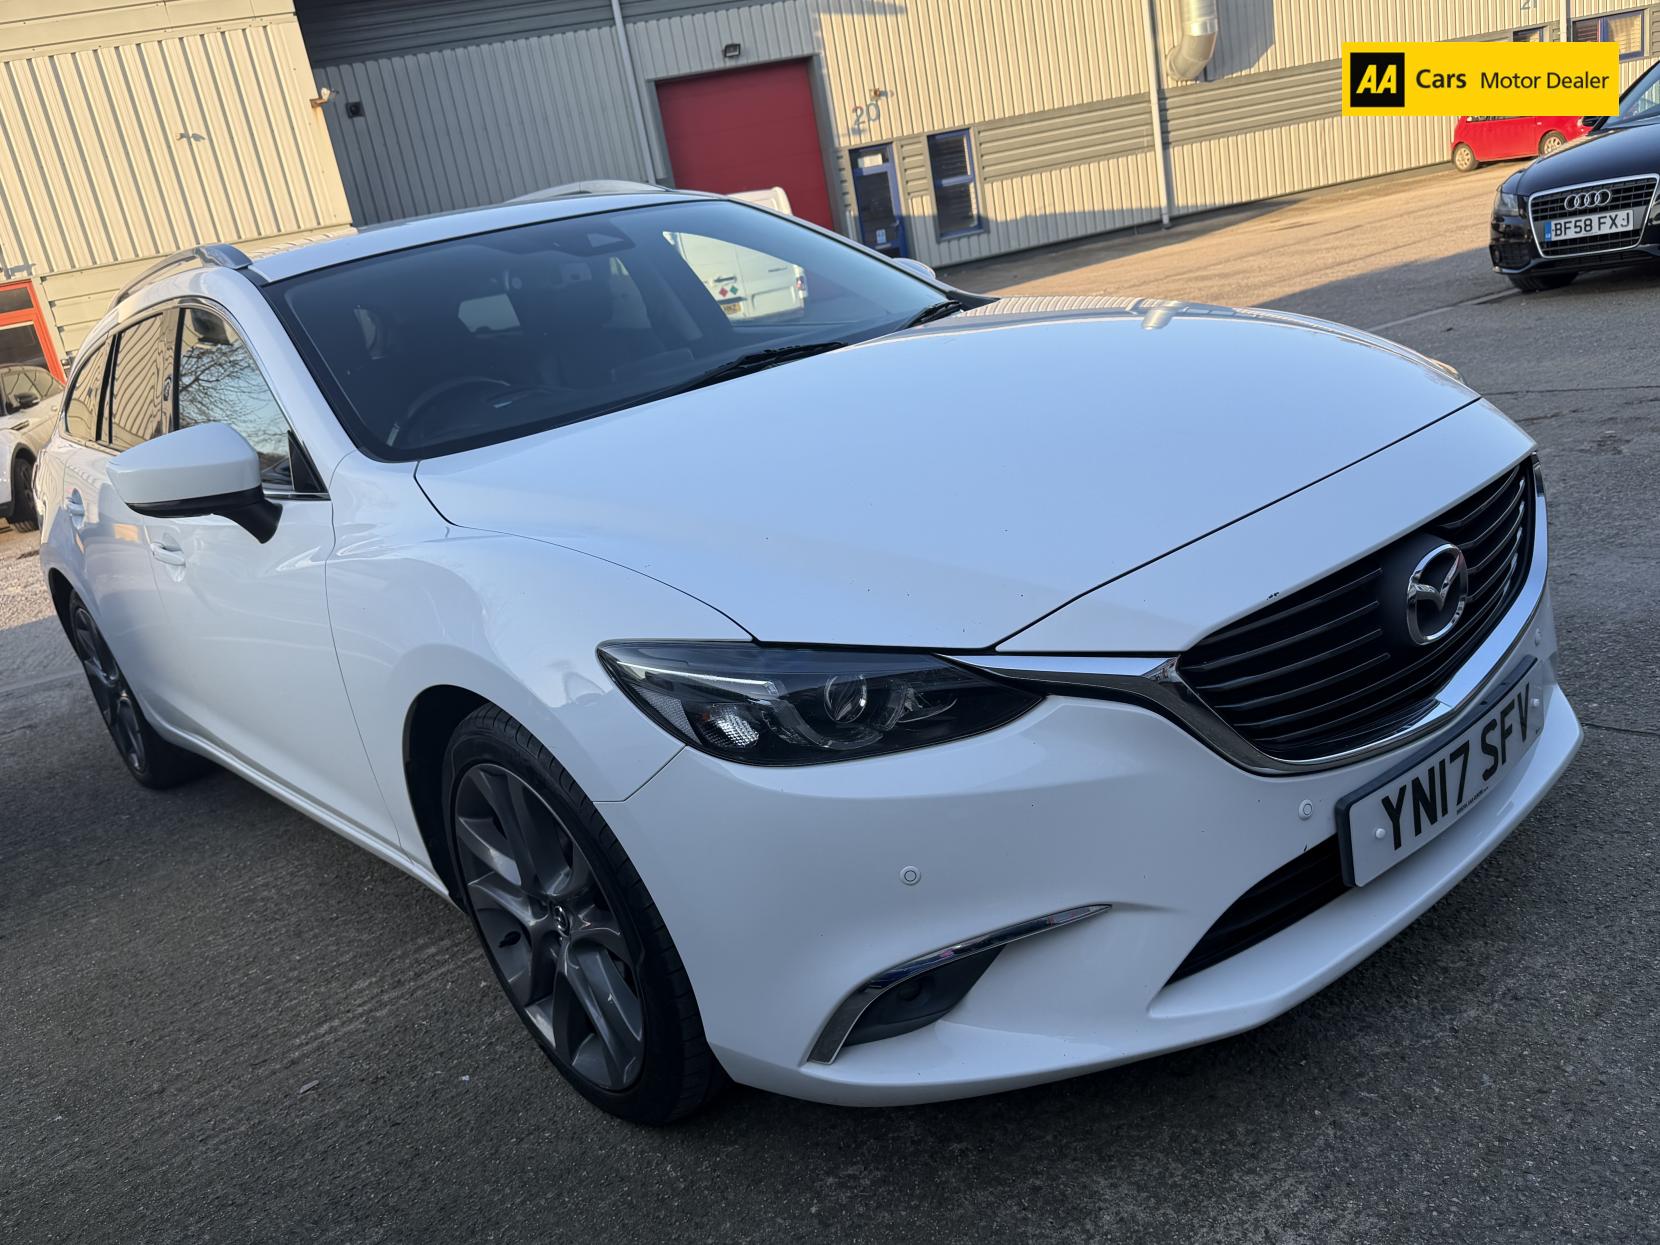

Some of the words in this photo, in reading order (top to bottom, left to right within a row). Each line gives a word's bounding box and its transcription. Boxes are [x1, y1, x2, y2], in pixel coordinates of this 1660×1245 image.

[852, 102, 880, 126] 20
[1554, 218, 1593, 237] BF58
[1598, 212, 1630, 231] FXJ
[1381, 739, 1470, 851] YN17
[1480, 682, 1530, 782] SFV
